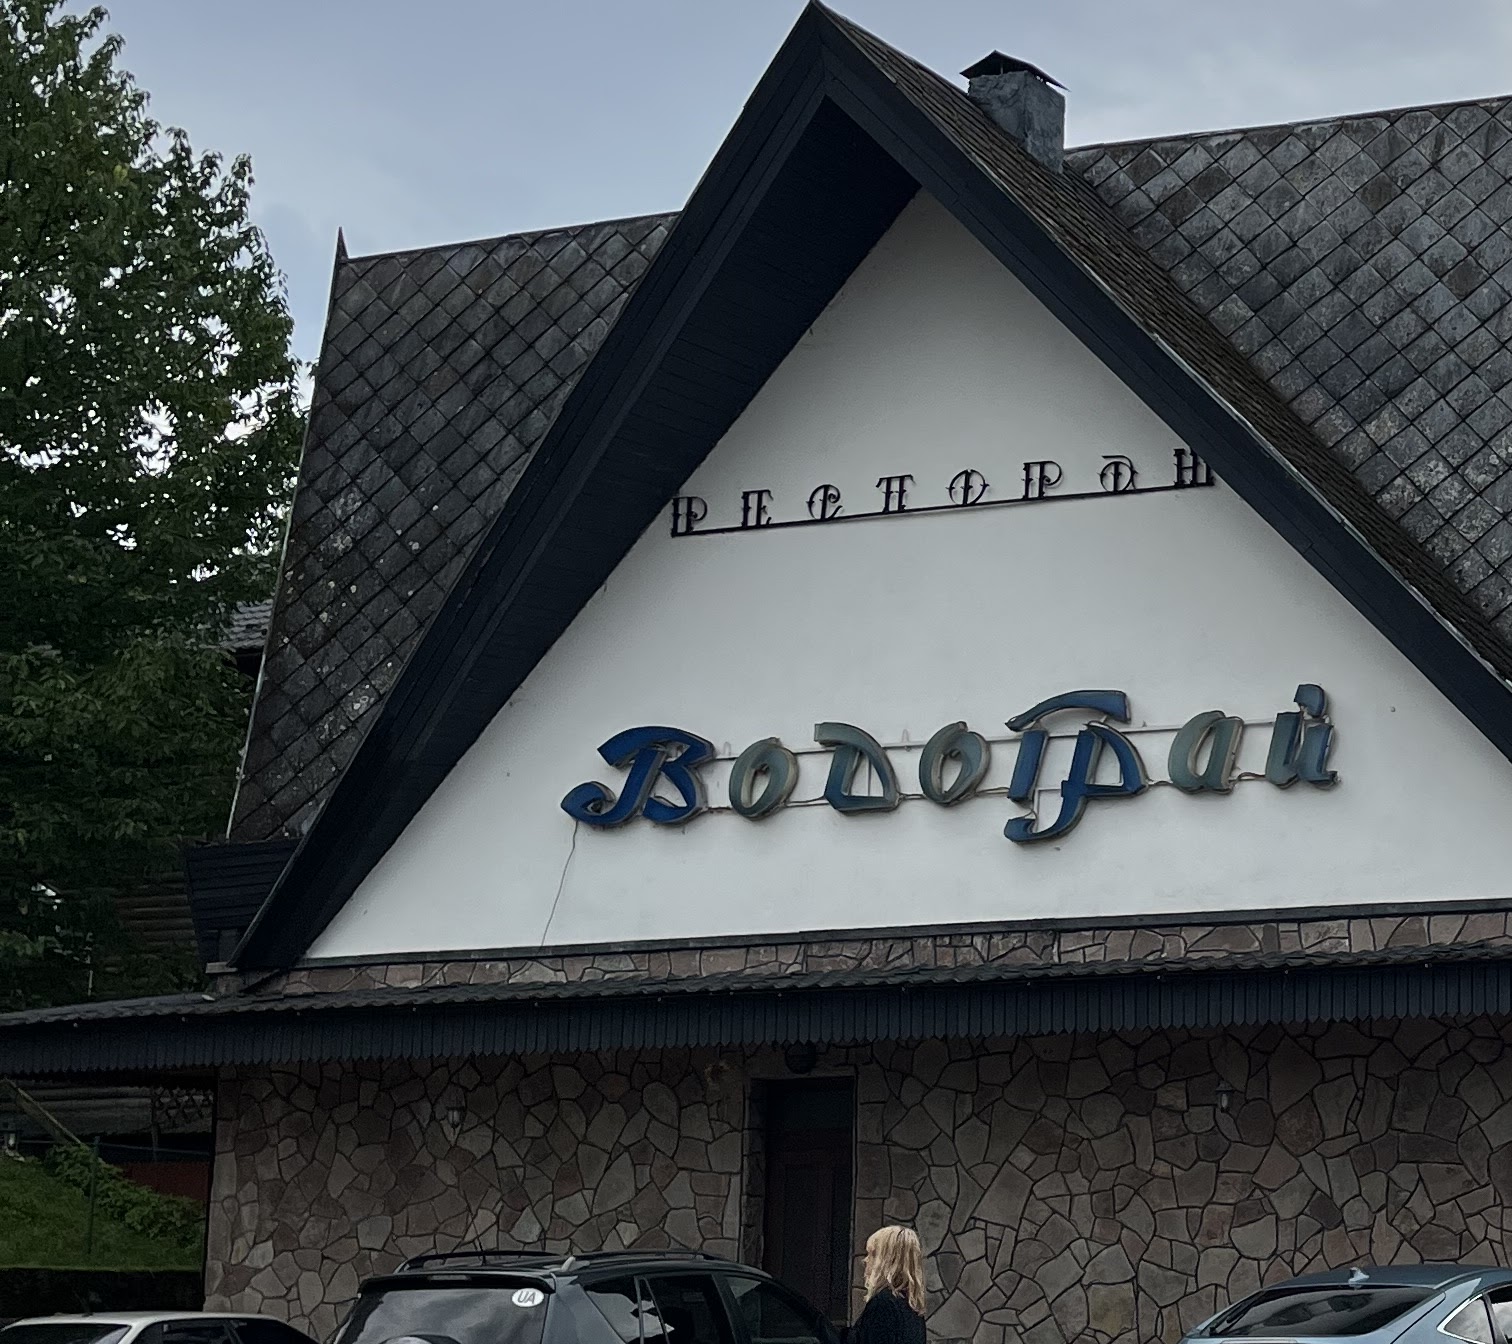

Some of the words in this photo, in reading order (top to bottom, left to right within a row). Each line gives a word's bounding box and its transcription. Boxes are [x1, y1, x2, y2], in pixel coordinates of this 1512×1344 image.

[671, 447, 1215, 536] РЕСТОРАН
[561, 683, 1342, 844] Водограй
[517, 1290, 537, 1305] UA
